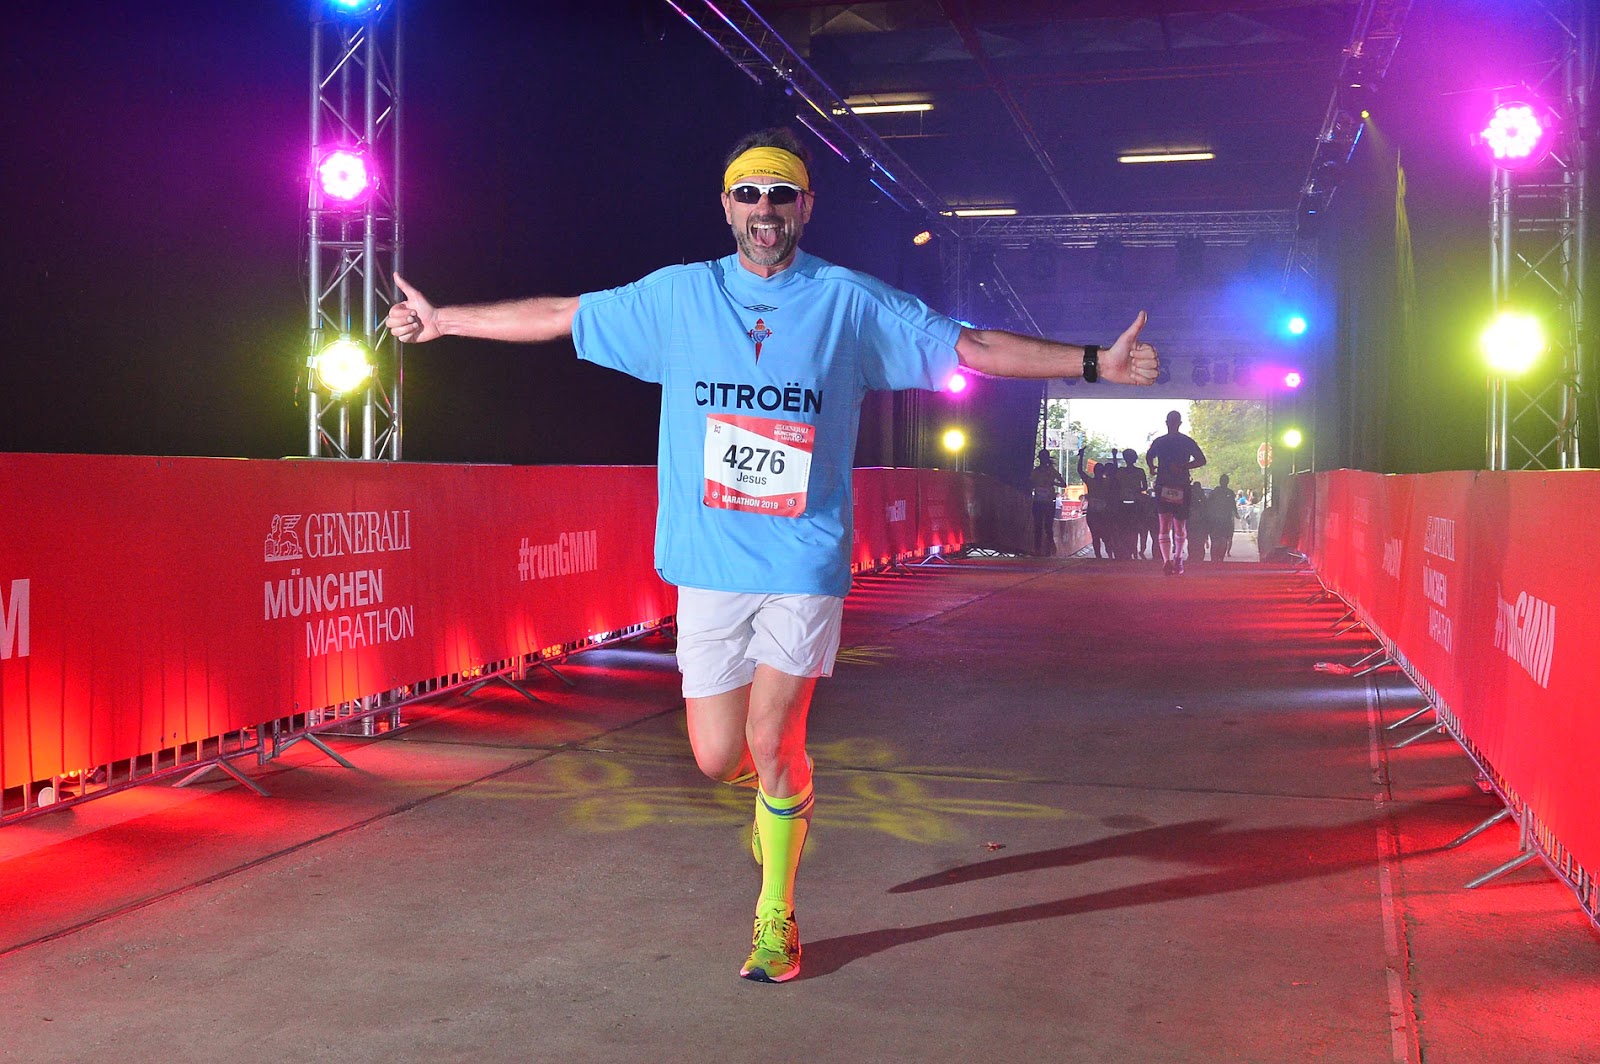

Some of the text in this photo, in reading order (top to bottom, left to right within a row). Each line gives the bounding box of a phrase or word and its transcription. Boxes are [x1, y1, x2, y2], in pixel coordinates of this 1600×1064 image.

[695, 381, 823, 414] CITROËN
[722, 444, 786, 475] 4276
[736, 472, 767, 486] Jesus
[722, 495, 779, 510] MARATHON 2019
[305, 510, 411, 557] GENERALI
[517, 529, 598, 582] #runGMM
[264, 568, 384, 621] MÜNCHEN
[306, 605, 415, 658] MARATHON
